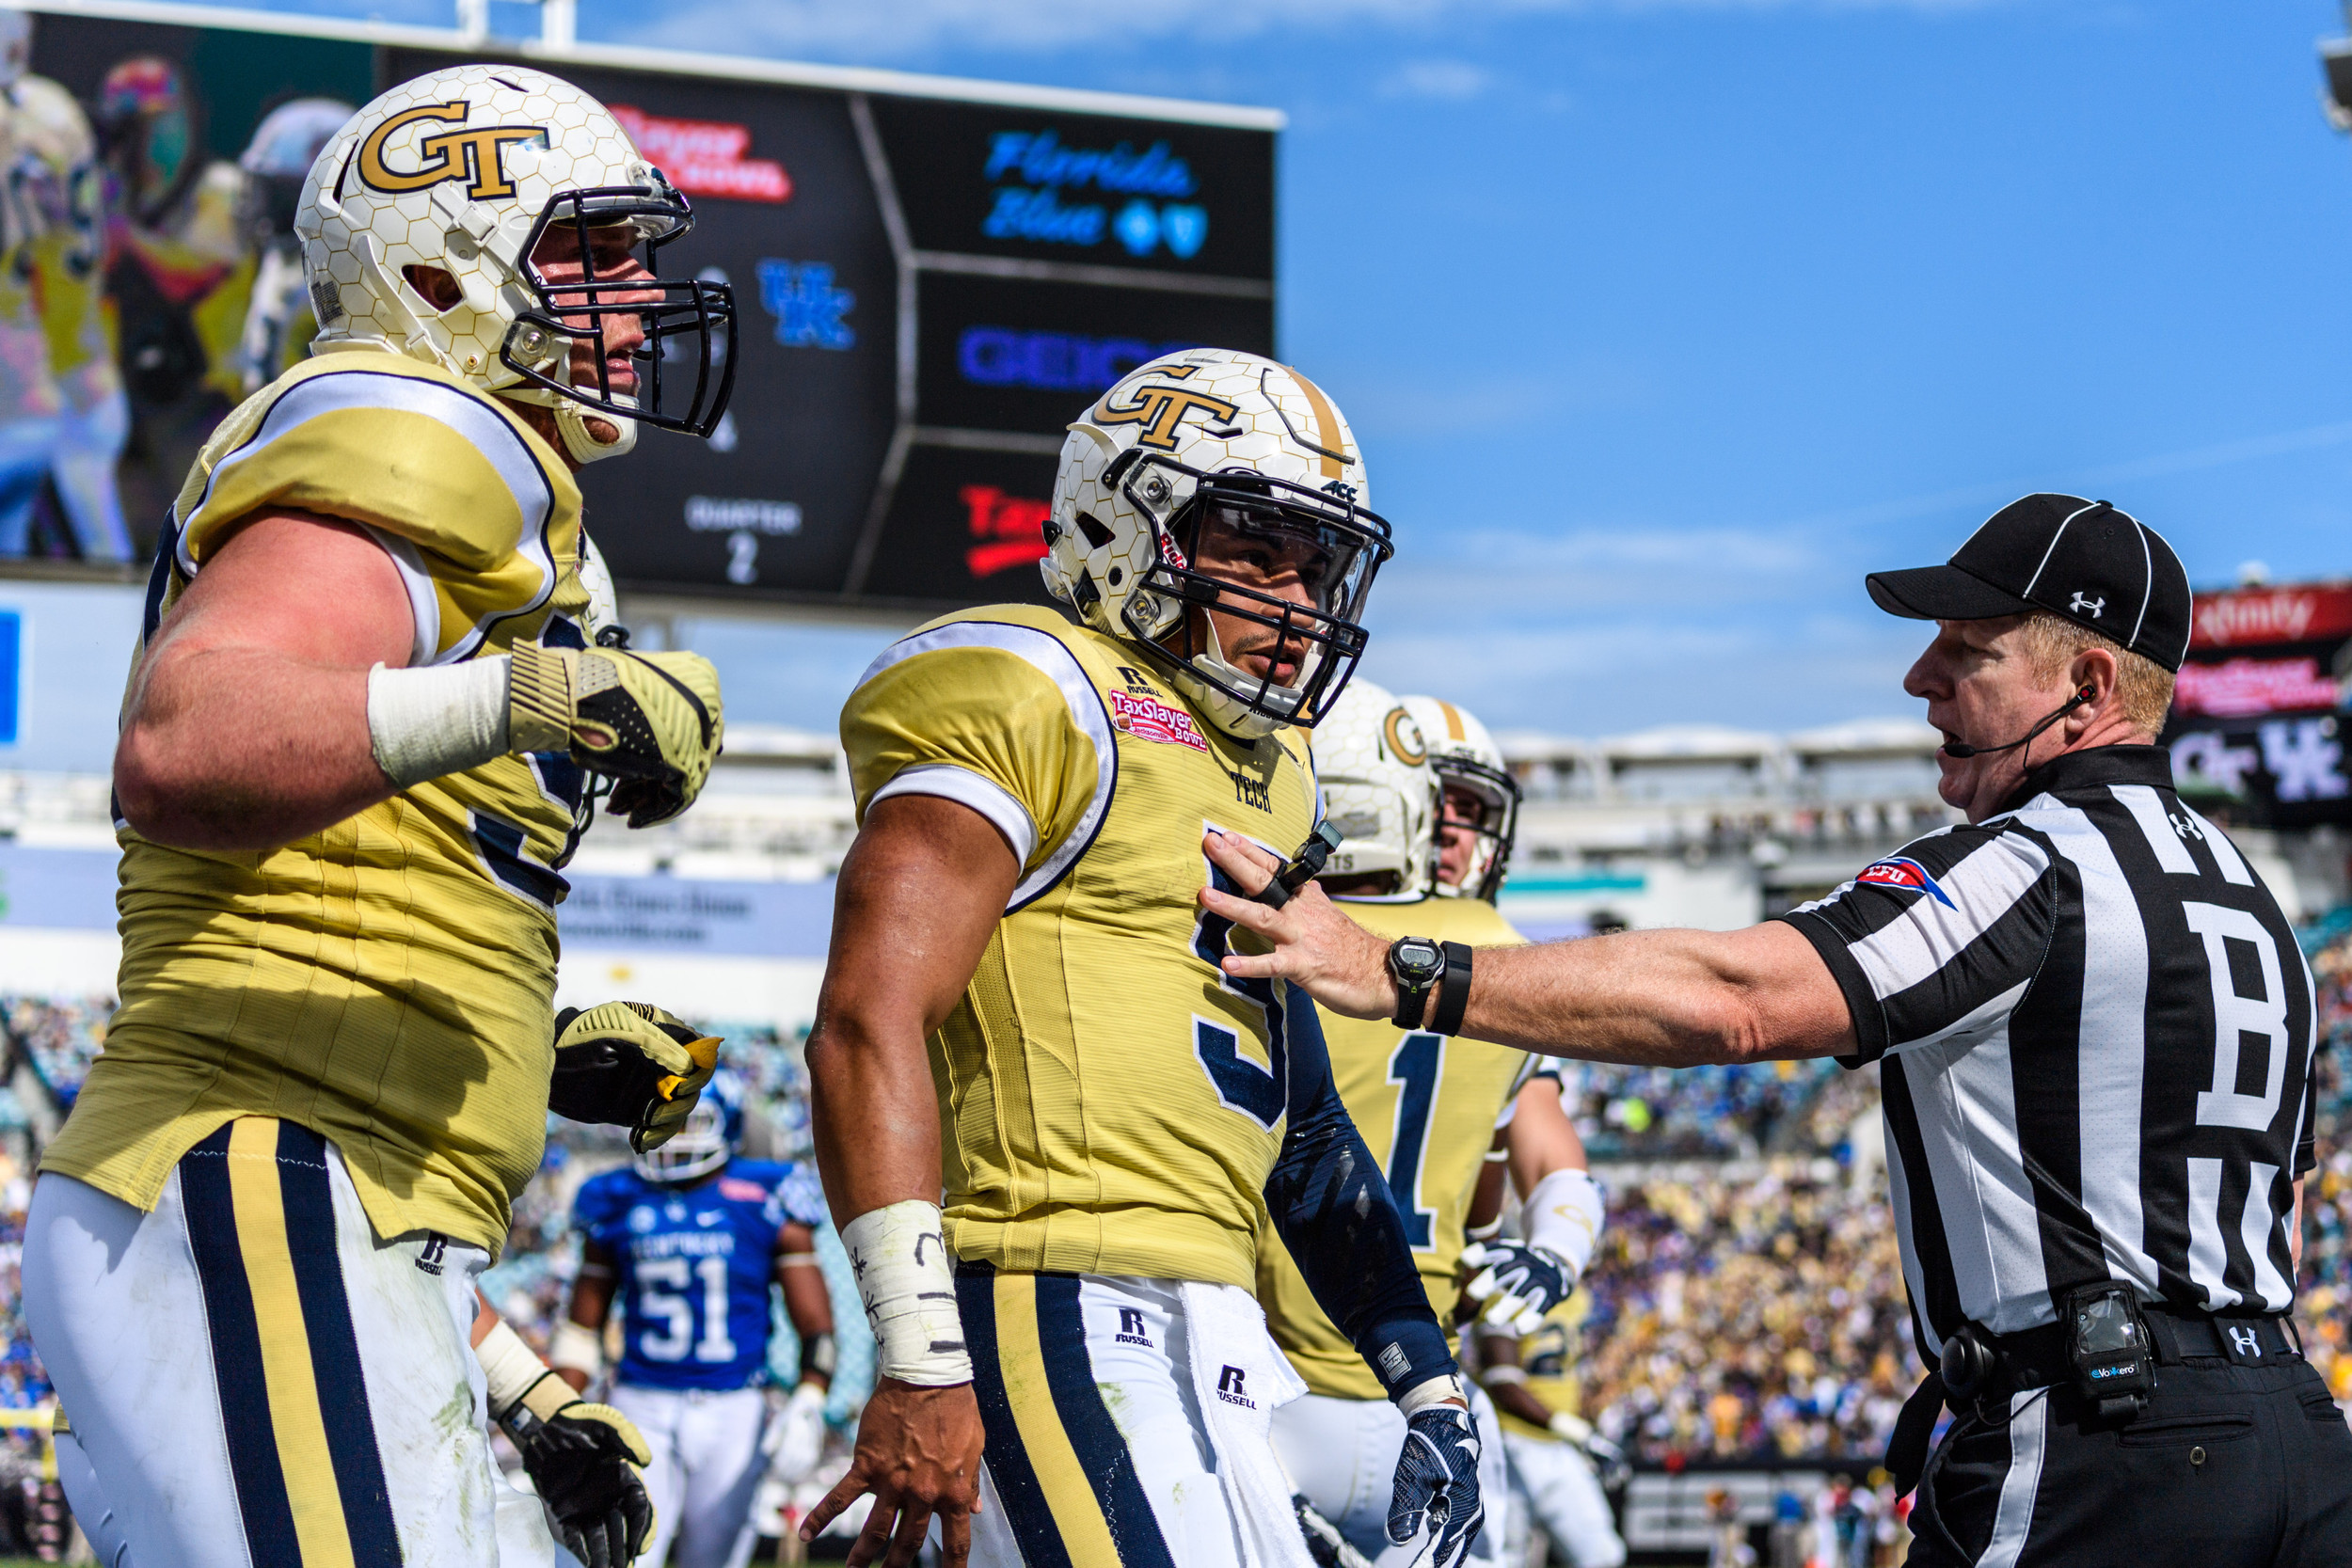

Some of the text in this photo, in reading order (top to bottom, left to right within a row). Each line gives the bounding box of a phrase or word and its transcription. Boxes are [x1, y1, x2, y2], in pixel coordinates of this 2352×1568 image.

[357, 100, 551, 202] GT
[957, 325, 1195, 392] GEIC
[1091, 364, 1241, 452] GT
[1320, 480, 1358, 503] ACC
[726, 531, 758, 585] 2
[1111, 691, 1192, 730] TaxSlayer
[1126, 685, 1164, 698] RUSSELL
[1174, 727, 1206, 749] BOWL
[1231, 770, 1273, 816] TECH
[2181, 900, 2290, 1132] B
[634, 1255, 739, 1364] 51
[1115, 1333, 1155, 1349] RUSSELL
